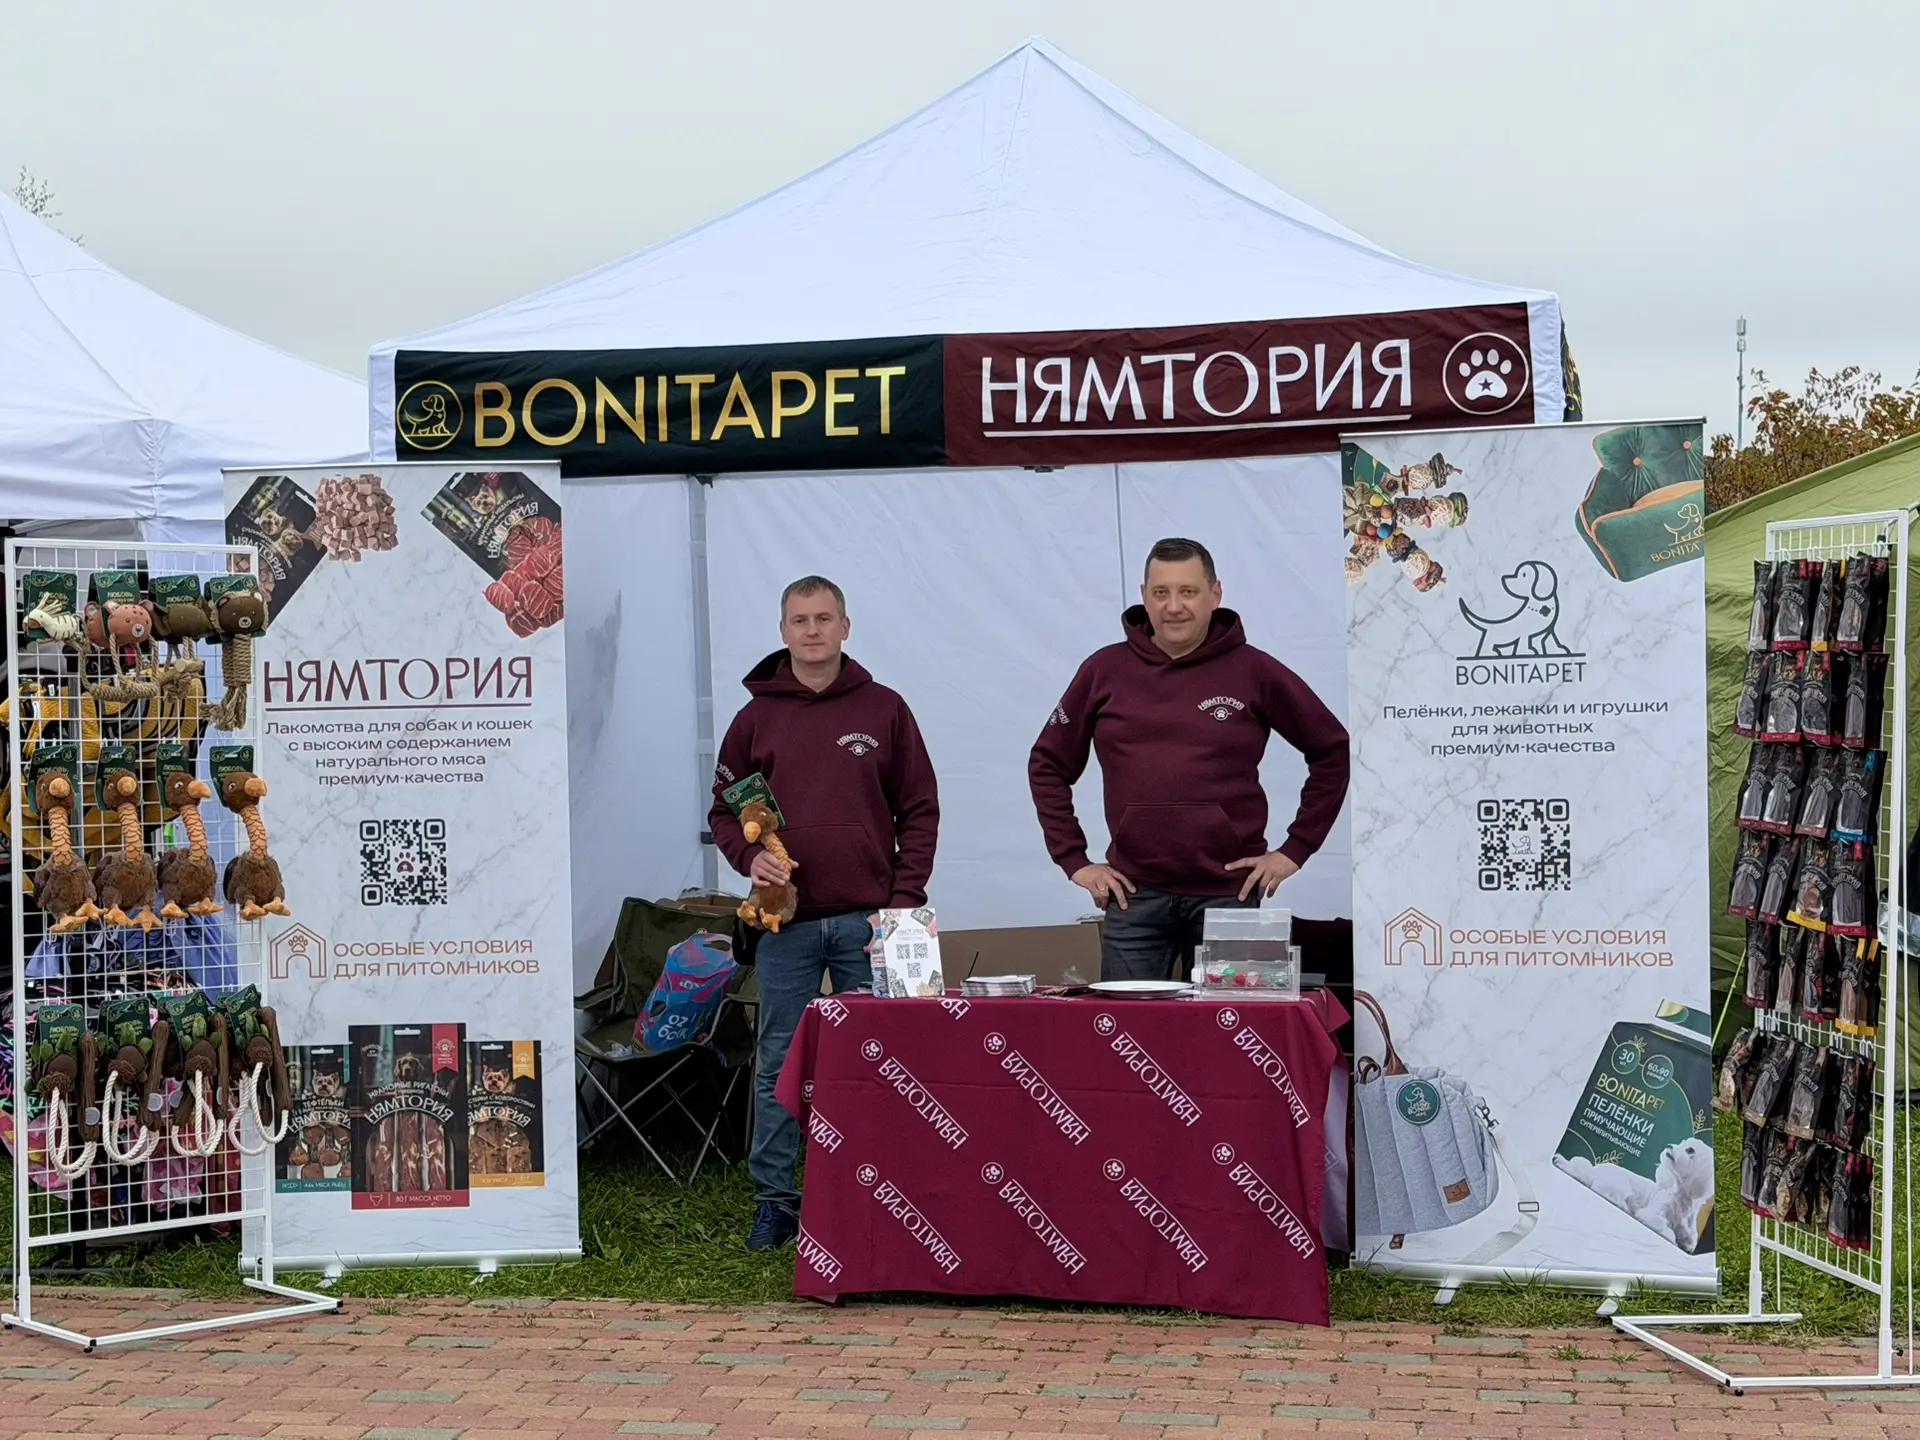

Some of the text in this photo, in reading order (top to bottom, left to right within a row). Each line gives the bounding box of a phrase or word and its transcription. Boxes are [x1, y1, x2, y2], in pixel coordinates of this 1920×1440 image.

[981, 338, 1412, 424] НЯМТОРИЯ
[474, 366, 906, 448] BONITAPET
[487, 501, 539, 559] НЯМТОРИЯ
[263, 656, 533, 703] НЯМТОРИЯ
[1456, 662, 1587, 686] BONITAPET
[1197, 696, 1245, 711] НЯМТОРИЯ
[1383, 701, 1669, 720] Пелёнки, лежанки и игрушки
[265, 718, 533, 735] Лакомства для собак и кошек
[1451, 721, 1594, 738] для животных
[288, 737, 511, 752] с высоким содержанием
[1431, 740, 1616, 758] премиум-качества
[315, 755, 487, 770] натурального мяса
[318, 772, 484, 787] премиум-качества
[333, 940, 533, 957] ОСОБЫЕ УСЛОВИЯ
[1449, 929, 1667, 945] ОСОБЫЕ УСЛОВИЯ
[333, 960, 540, 980] ДЛЯ ПИТОМНИКОВ
[1450, 951, 1674, 968] ДЛЯ ПИТОМНИКОВ
[1618, 1048, 1636, 1065] 30
[1110, 1033, 1200, 1127] НЯМТОРИЯ
[1233, 1027, 1309, 1128] НЯМТОРИЯ
[363, 1095, 454, 1123] НЯМТОРИЯ
[878, 1057, 968, 1150] НЯМТОРИЯ
[1001, 1051, 1089, 1146] НЯМТОРИЯ
[287, 1110, 351, 1133] НЯМТОРИ
[467, 1106, 532, 1128] ЯМТОРИЯ
[1588, 1092, 1655, 1137] ПЕЛЁНКИ
[1583, 1107, 1648, 1149] ПРИУЧАЮЩИЕ
[1229, 1162, 1315, 1260] НЯМТОРИЯ
[872, 1180, 961, 1275] НЯМТОРИЯ
[999, 1179, 1087, 1275] НЯМТОРИЯ
[1120, 1178, 1208, 1274] НЯМТОРИЯ
